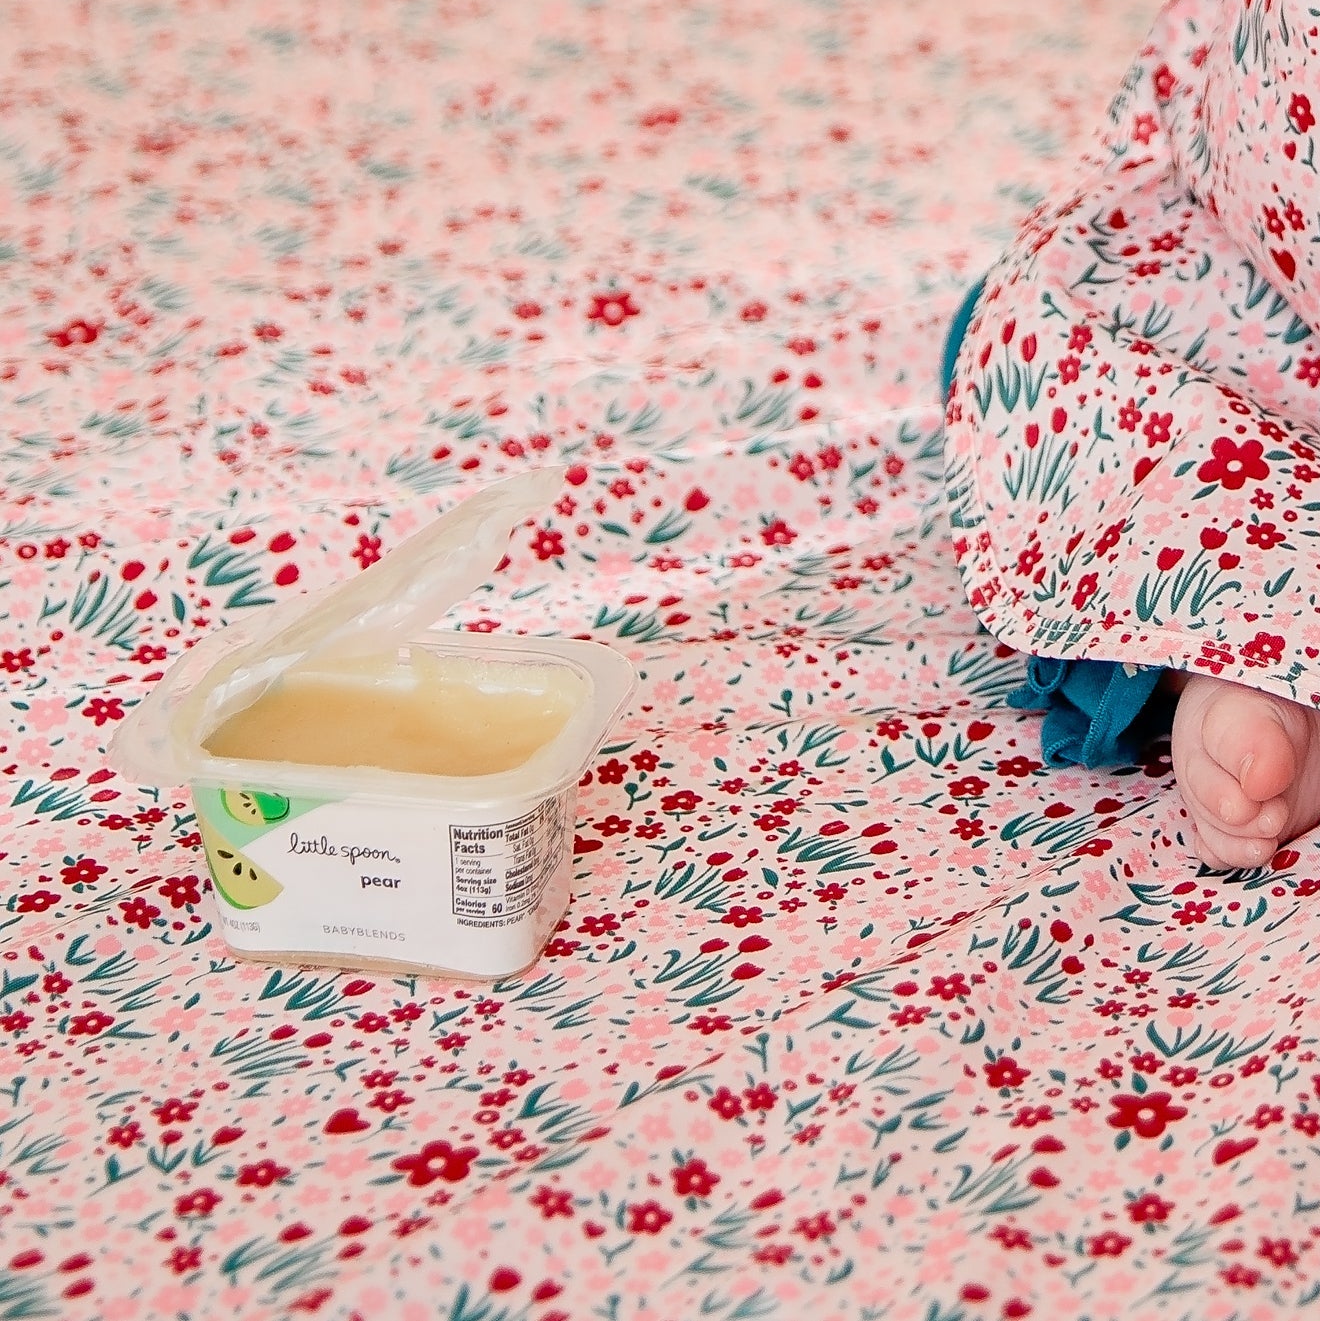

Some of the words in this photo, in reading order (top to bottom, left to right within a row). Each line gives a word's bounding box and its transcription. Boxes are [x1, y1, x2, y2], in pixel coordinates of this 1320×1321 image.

[453, 827, 503, 841] Nutrition
[505, 830, 520, 843] Total
[520, 826, 529, 838] Fat
[287, 832, 338, 856] little
[454, 841, 486, 854] Facts
[460, 859, 481, 868] serving
[465, 867, 492, 875] container
[360, 875, 401, 889] pear
[455, 875, 481, 886] Serving
[483, 877, 497, 885] size
[456, 884, 468, 892] 4oz
[469, 885, 492, 895] (113g)
[455, 897, 487, 908] Calories
[491, 902, 503, 914] 60
[465, 908, 486, 916] serving
[457, 918, 507, 929] INGREDIENTS:
[322, 924, 406, 942] BABYBLENDS
